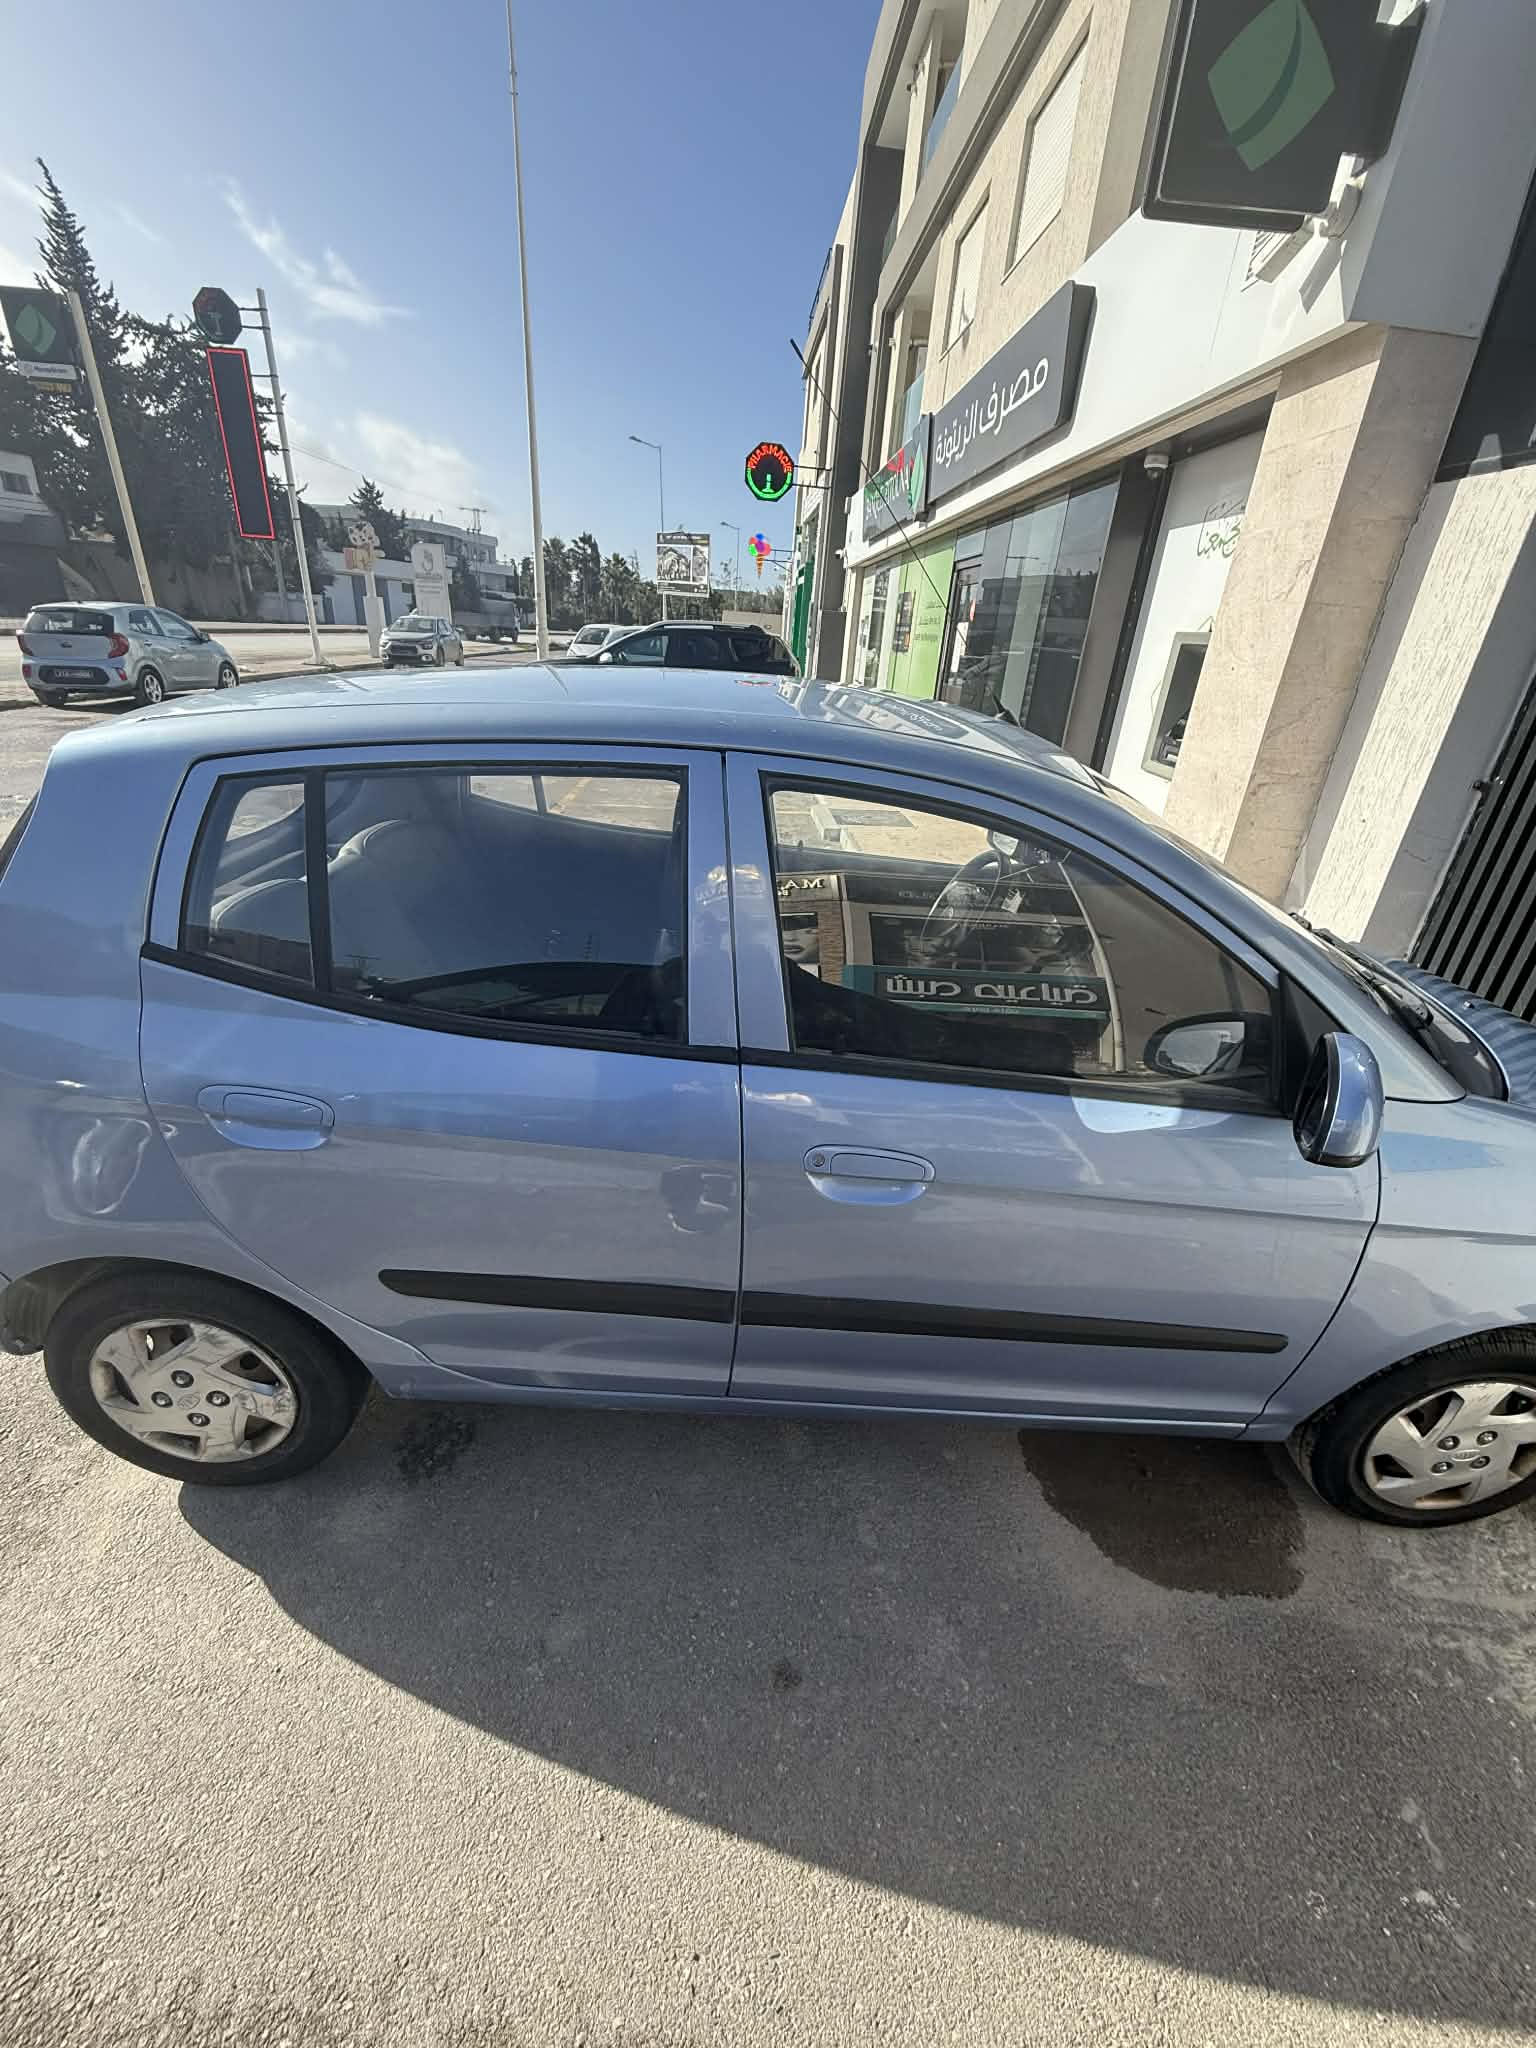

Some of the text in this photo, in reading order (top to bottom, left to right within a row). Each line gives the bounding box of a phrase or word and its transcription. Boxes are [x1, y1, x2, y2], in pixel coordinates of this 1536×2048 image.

[935, 357, 1049, 469] مصرف الزيتونة
[747, 444, 793, 473] PHARMACIE
